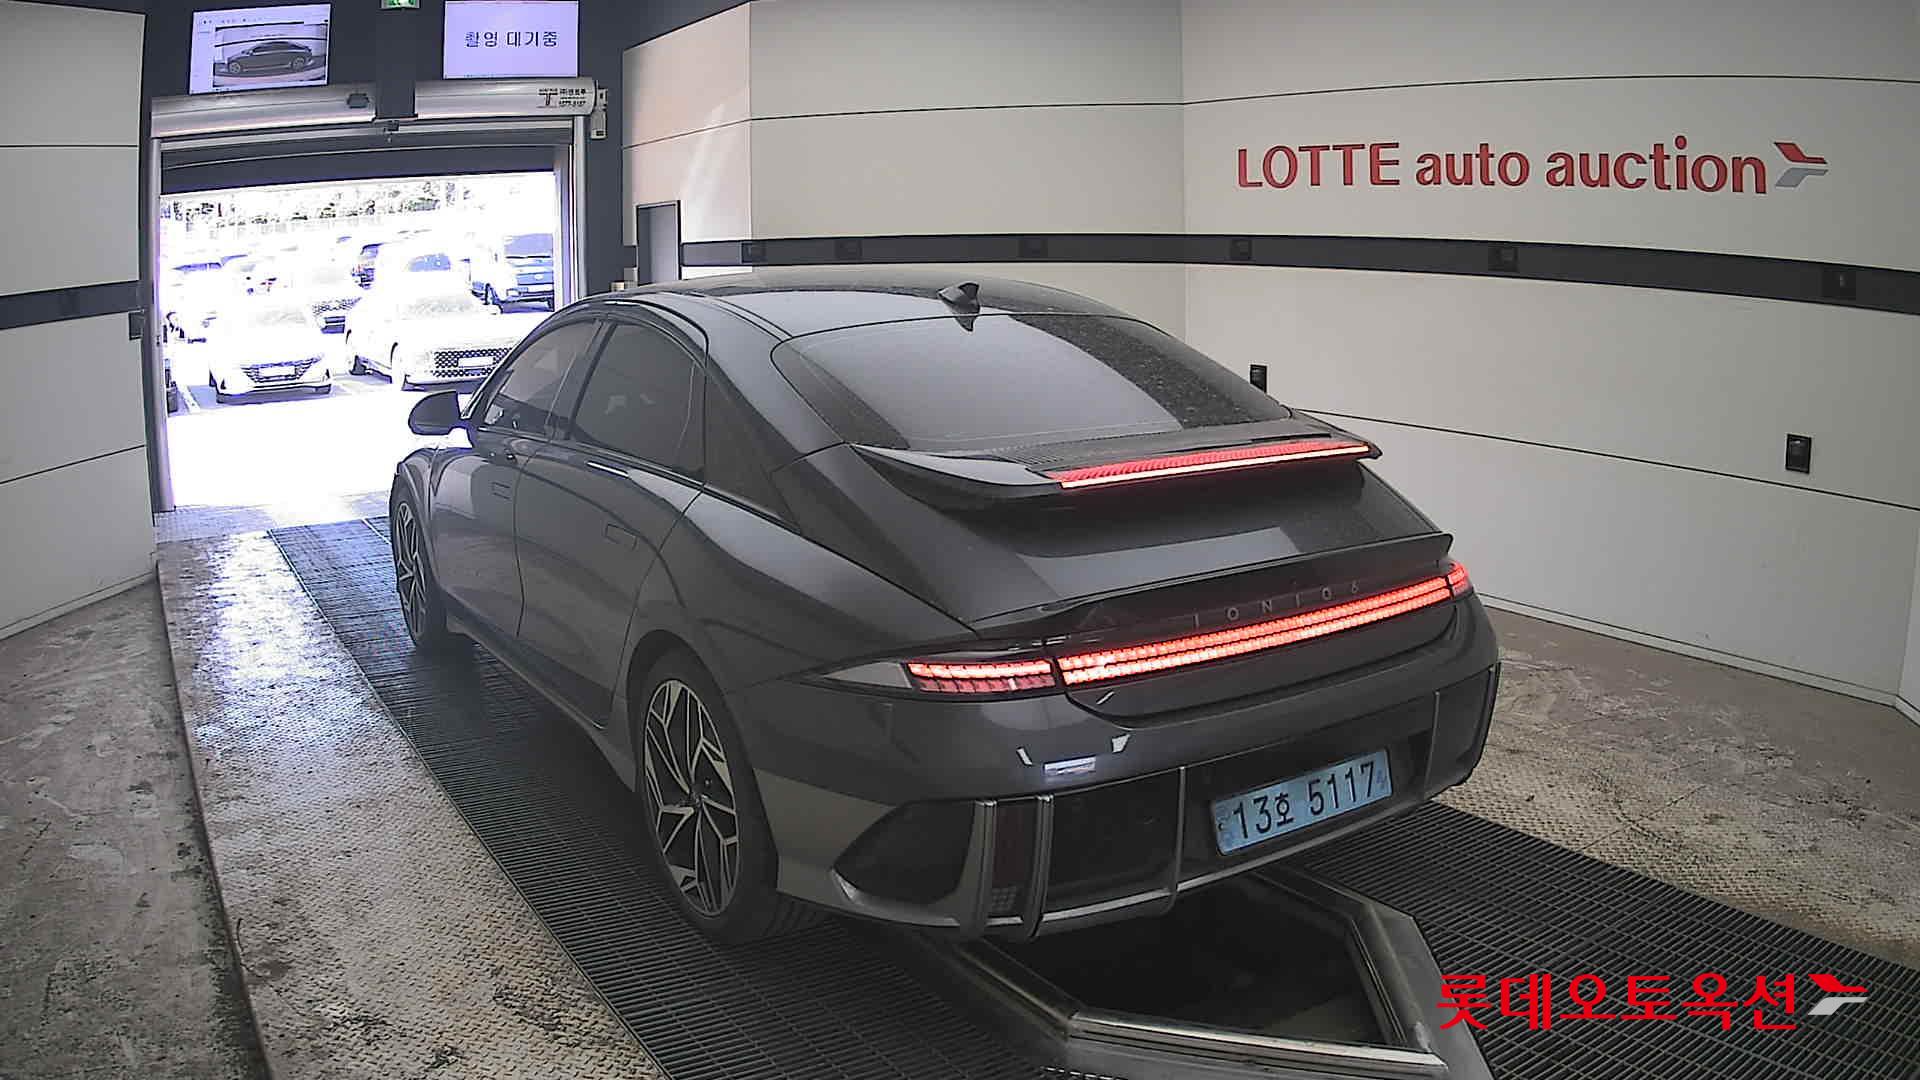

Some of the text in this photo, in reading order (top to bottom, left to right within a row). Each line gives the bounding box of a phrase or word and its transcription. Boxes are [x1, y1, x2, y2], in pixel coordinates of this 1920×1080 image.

[506, 31, 558, 48] 대기중
[1237, 135, 1768, 193] LOTTE auto auction
[1233, 761, 1375, 839] 13호 5117
